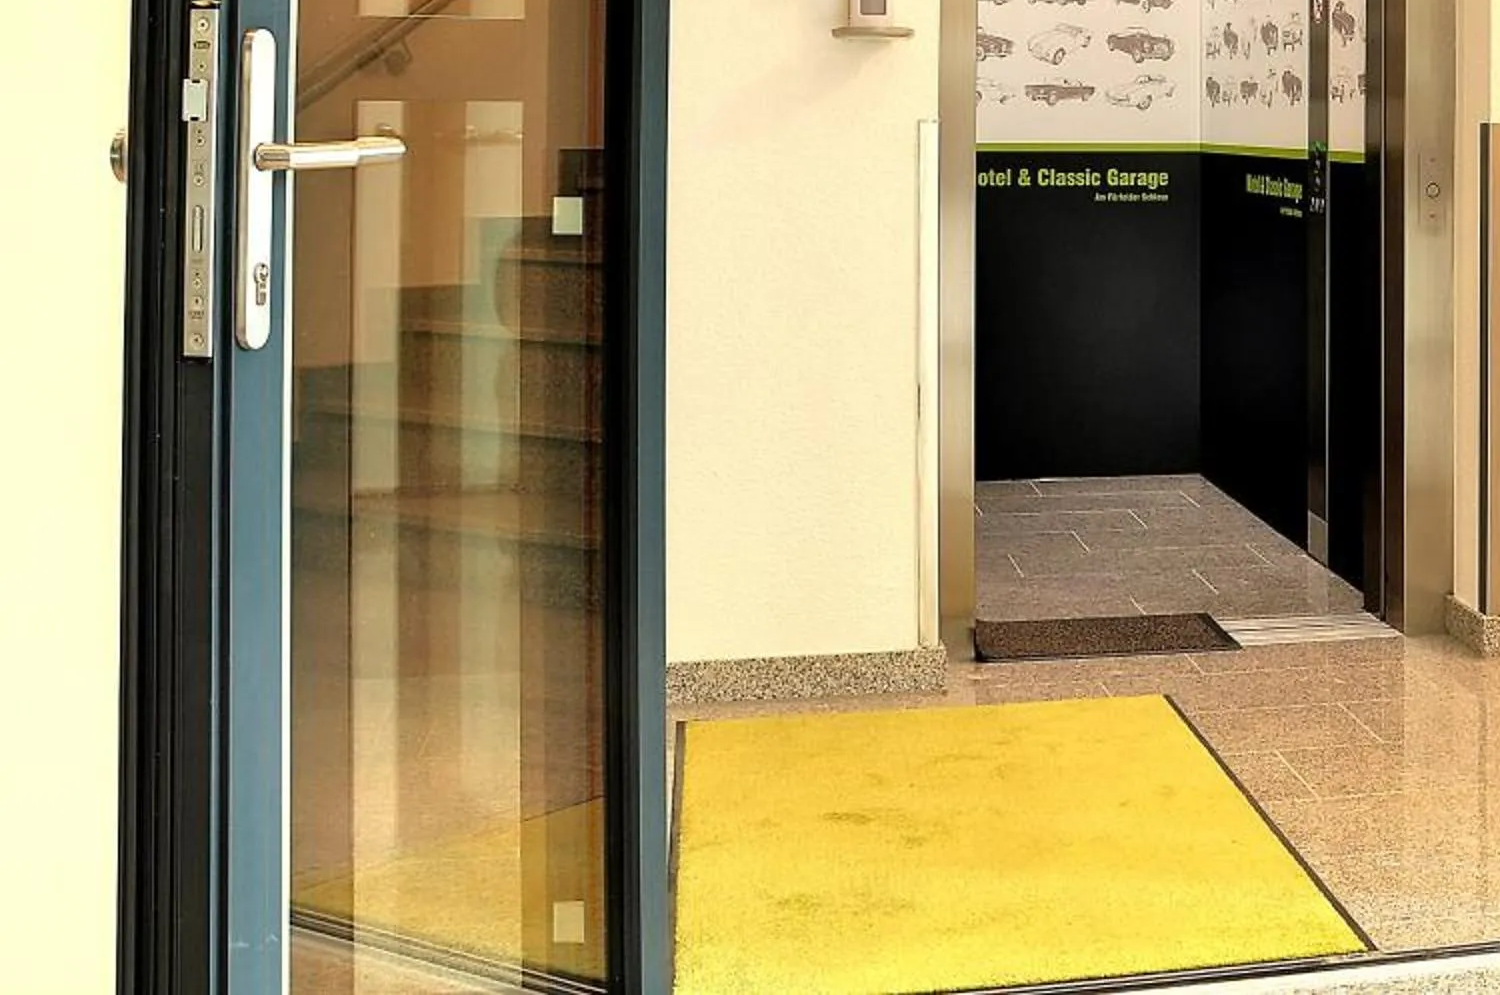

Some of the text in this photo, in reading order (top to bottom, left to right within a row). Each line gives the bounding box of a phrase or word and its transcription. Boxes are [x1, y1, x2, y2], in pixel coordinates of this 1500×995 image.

[1018, 168, 1031, 186] &
[1037, 168, 1101, 187] Classic
[1107, 168, 1169, 189] Garage
